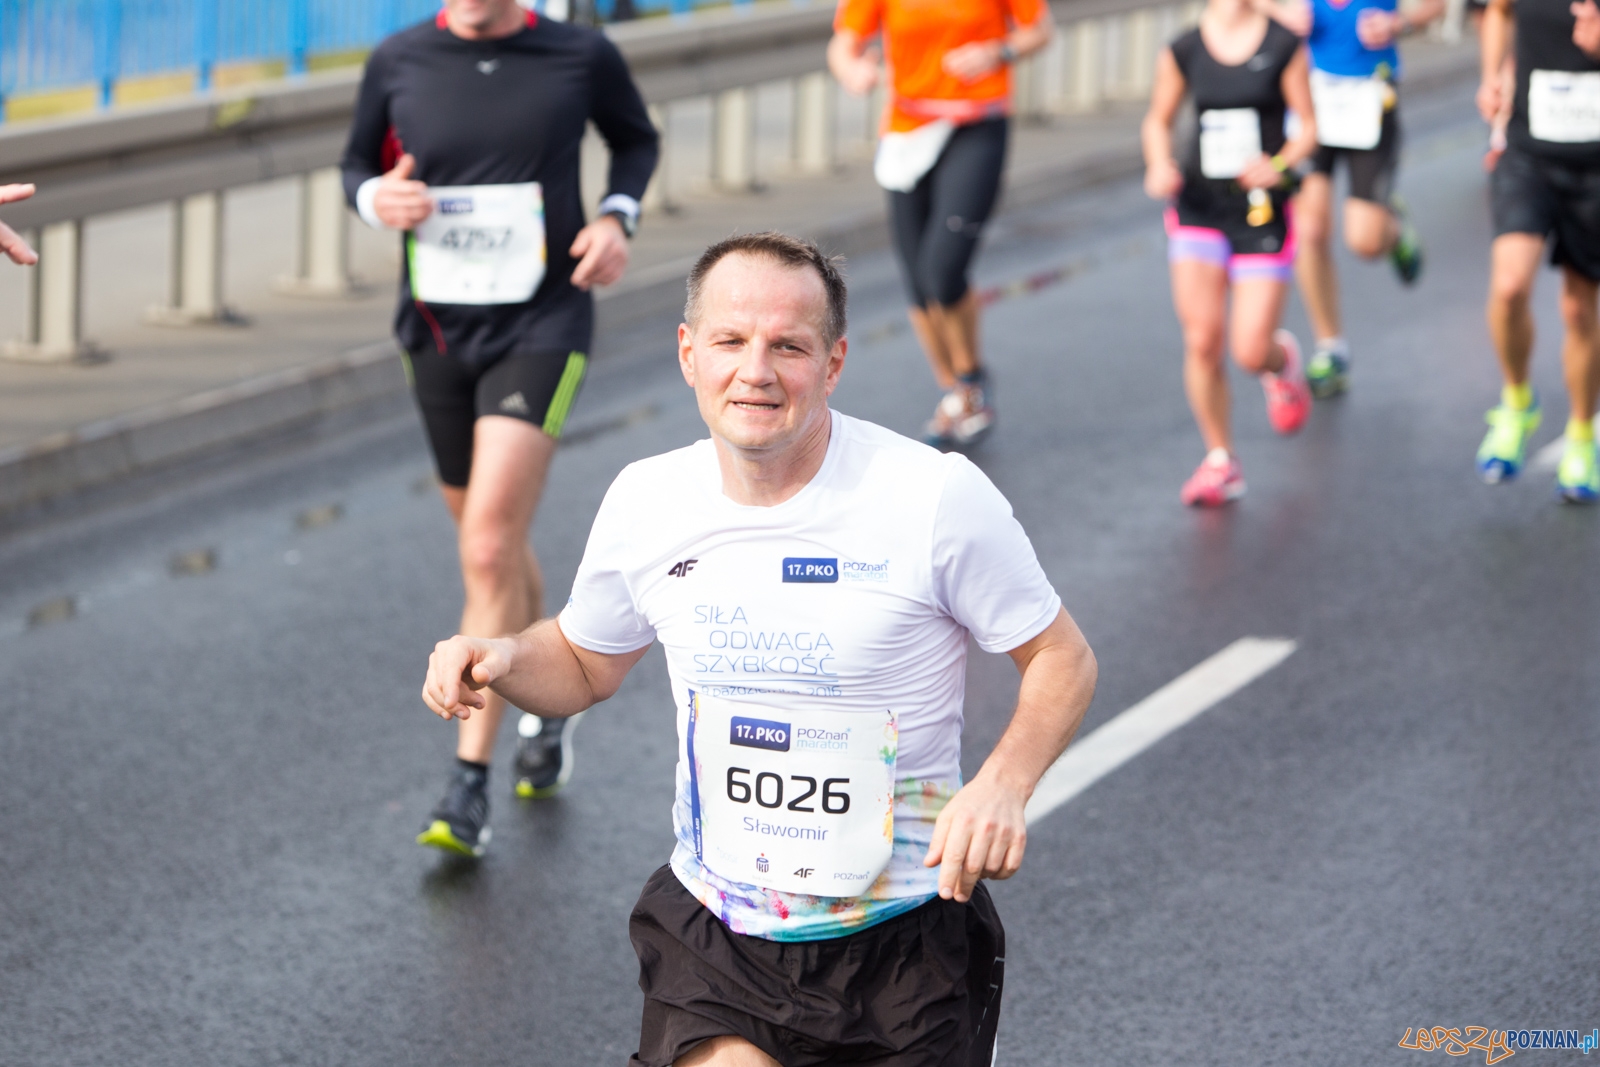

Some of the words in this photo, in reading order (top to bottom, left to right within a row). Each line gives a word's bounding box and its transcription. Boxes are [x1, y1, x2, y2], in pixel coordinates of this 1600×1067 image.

[786, 564, 804, 576] 17.
[806, 565, 834, 577] PKO
[694, 605, 748, 625] SIŁA
[709, 630, 834, 651] ODWAGA
[693, 653, 838, 676] SZYBKOŚĆ
[735, 724, 754, 740] 17.
[756, 728, 787, 744] PKO
[796, 738, 848, 750] maraton
[726, 766, 851, 815] 6026
[743, 816, 829, 841] Sławomir
